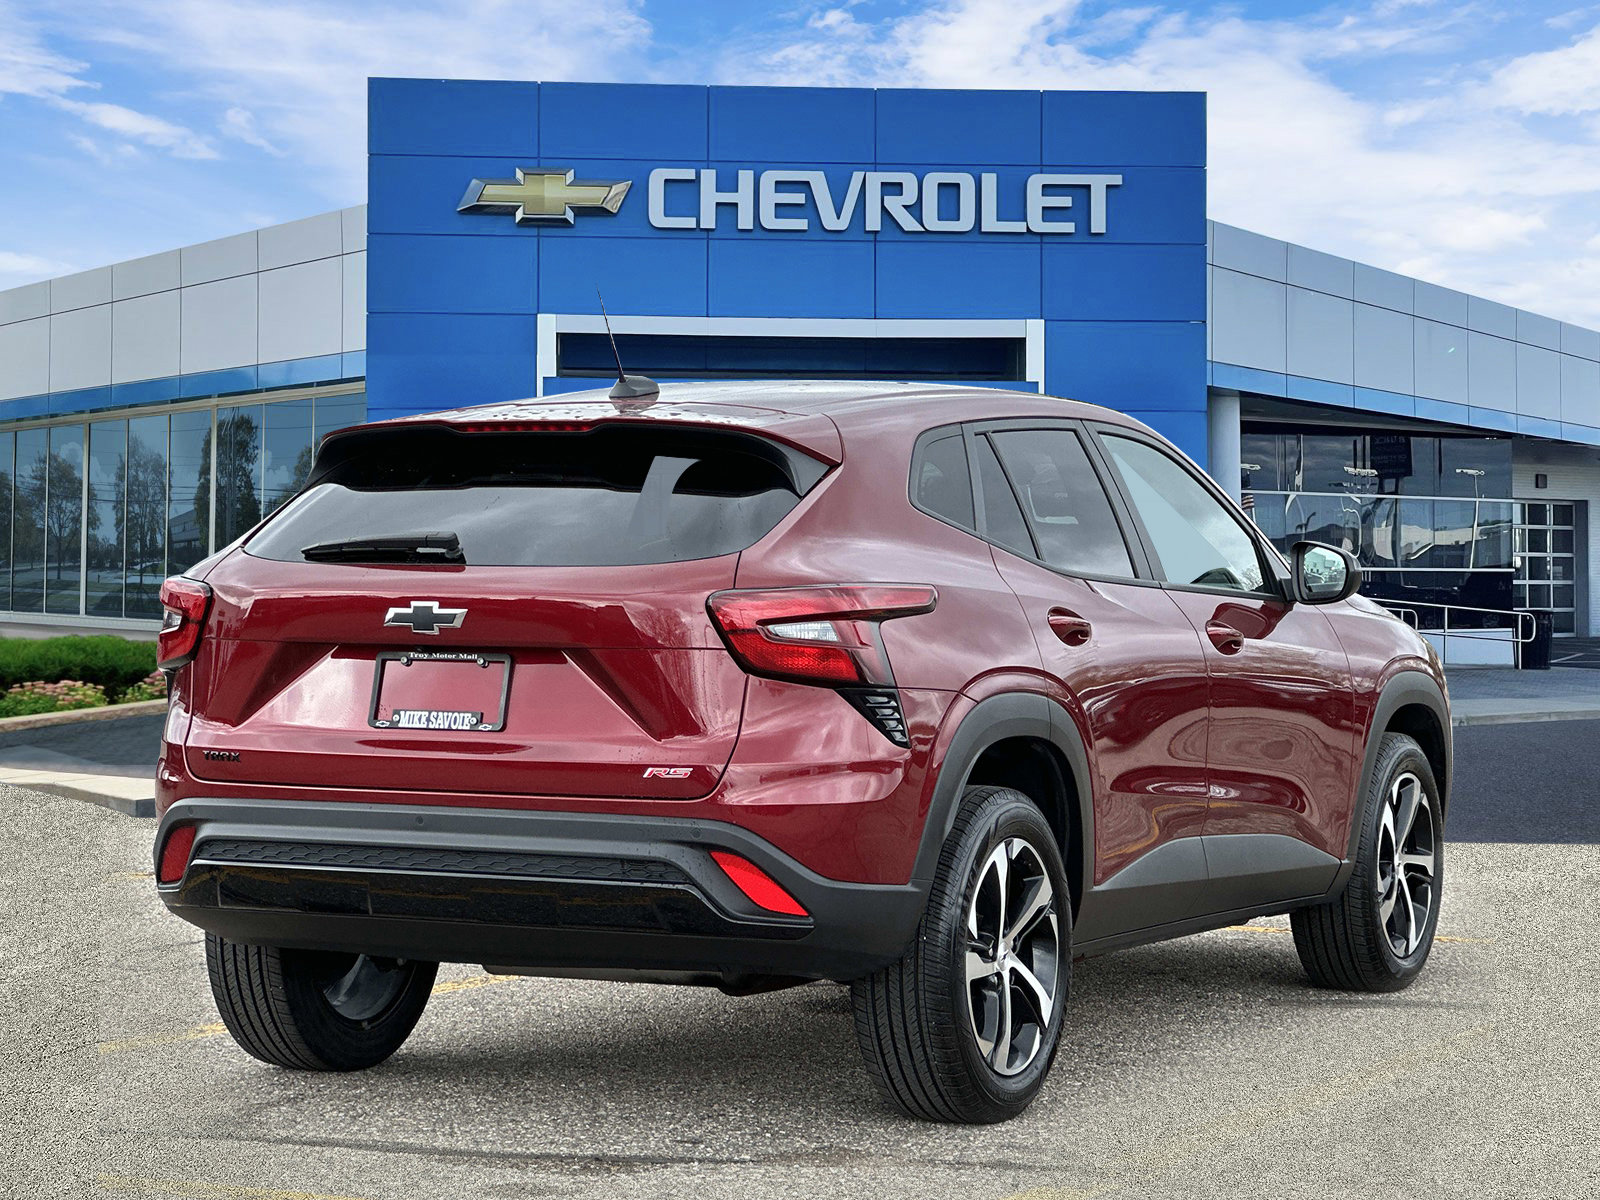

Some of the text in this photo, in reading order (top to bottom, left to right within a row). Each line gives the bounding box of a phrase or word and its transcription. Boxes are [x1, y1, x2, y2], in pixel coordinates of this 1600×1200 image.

[648, 168, 1123, 235] CHEVROLET
[408, 651, 428, 659] Troy
[398, 710, 472, 730] MIKE SAVOIE
[202, 750, 241, 762] TRAX
[642, 767, 693, 779] RS
